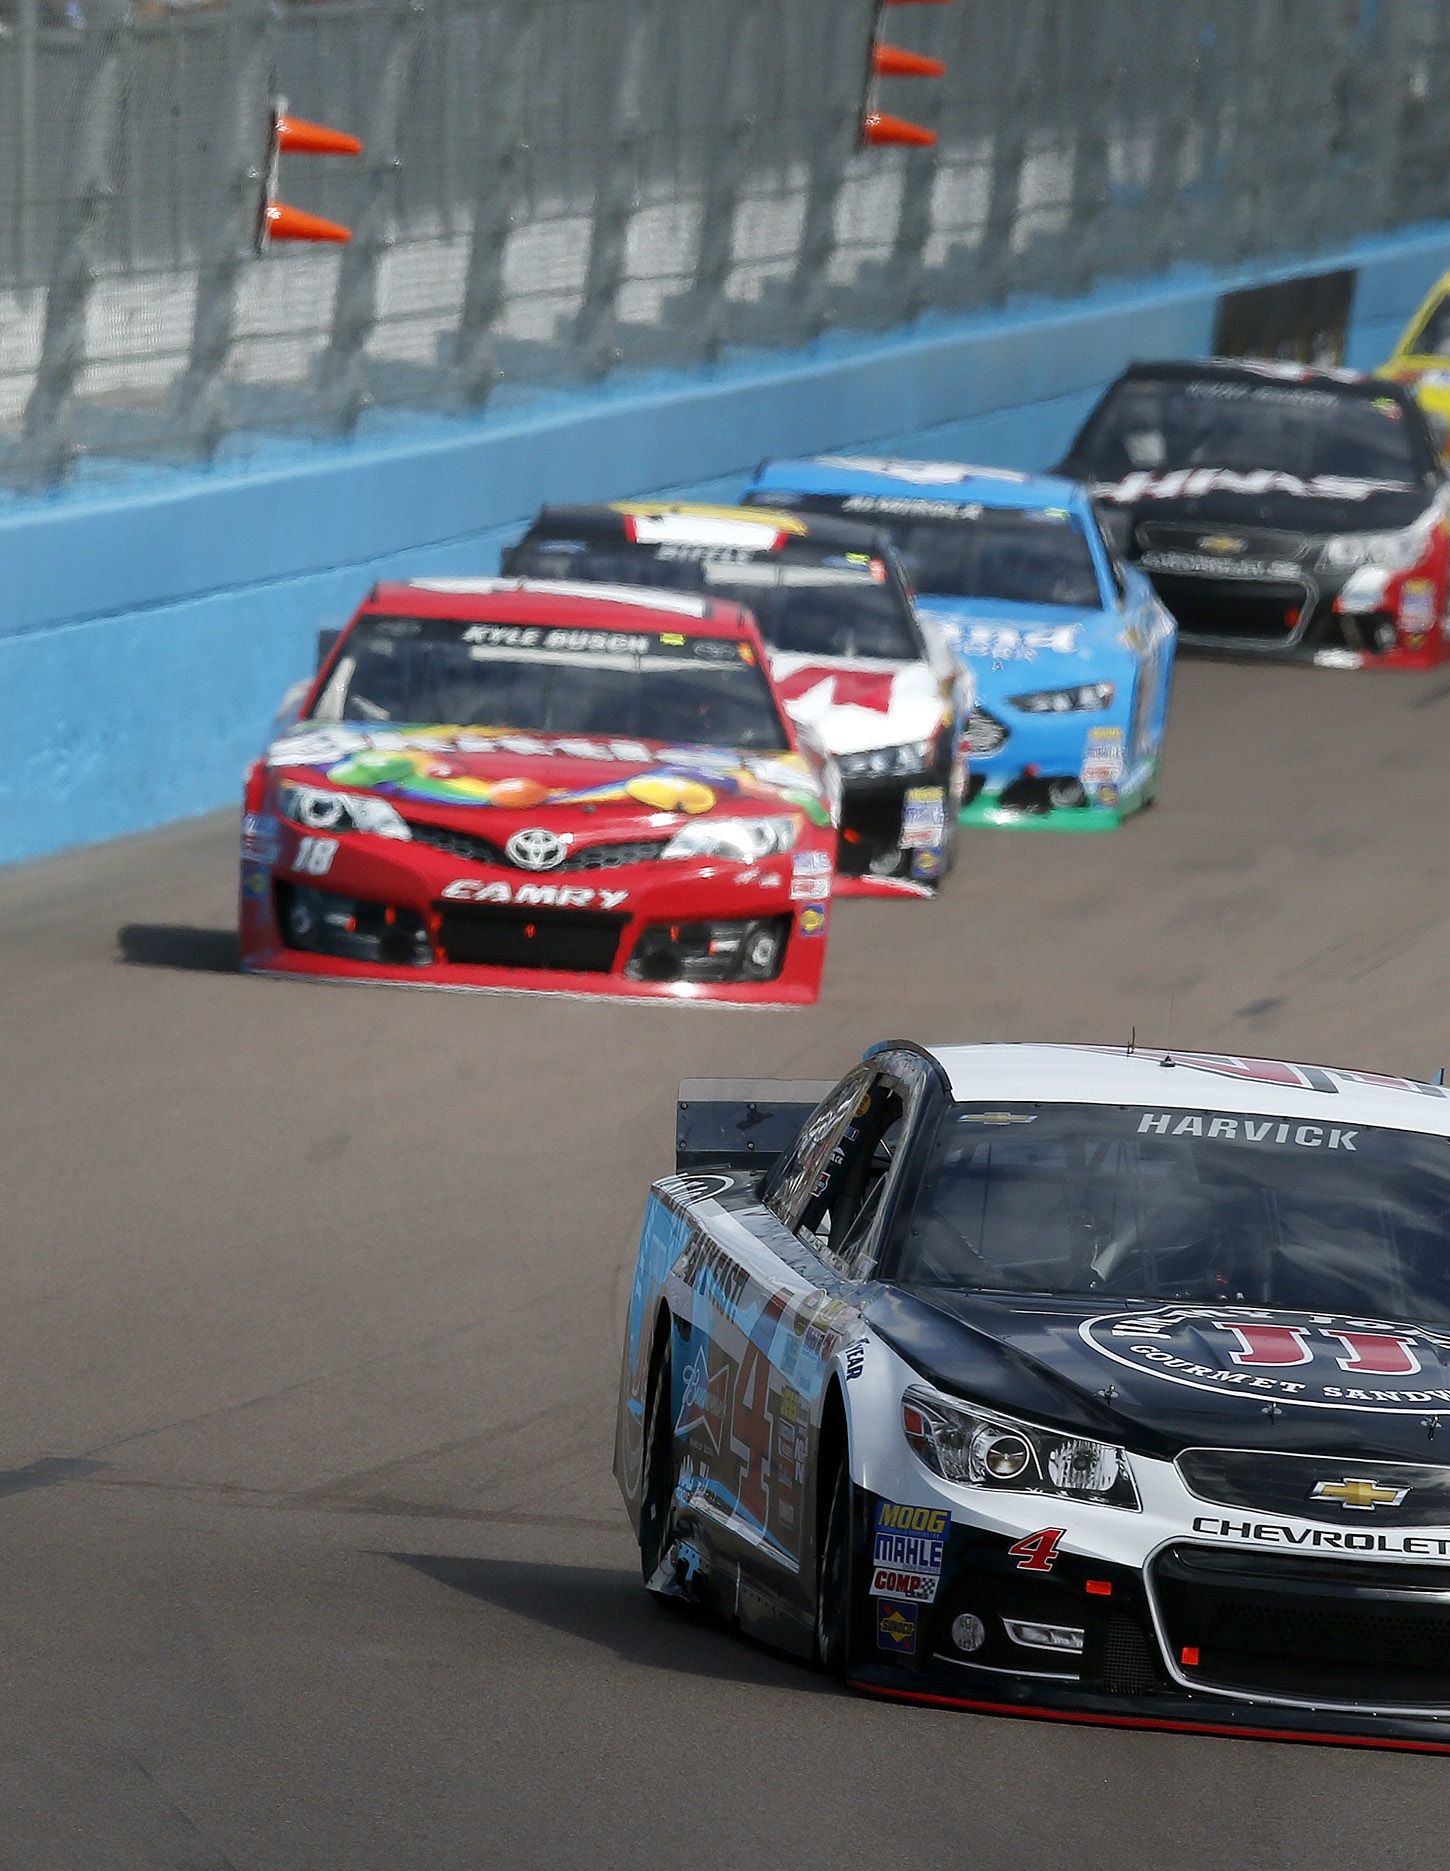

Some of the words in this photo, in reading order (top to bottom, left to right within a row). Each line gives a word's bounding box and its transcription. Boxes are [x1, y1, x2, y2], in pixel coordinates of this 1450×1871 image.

[462, 623, 543, 647] KYLE
[543, 629, 649, 653] BUSCH
[291, 836, 340, 876] 18
[441, 878, 630, 910] CAMRY
[1137, 1113, 1359, 1151] HARVICK
[1129, 1345, 1307, 1394] GOURMET
[878, 1503, 948, 1534] MOOG
[875, 1533, 942, 1568] MAHLE
[1008, 1527, 1067, 1572] 4
[875, 1570, 922, 1593] COMP
